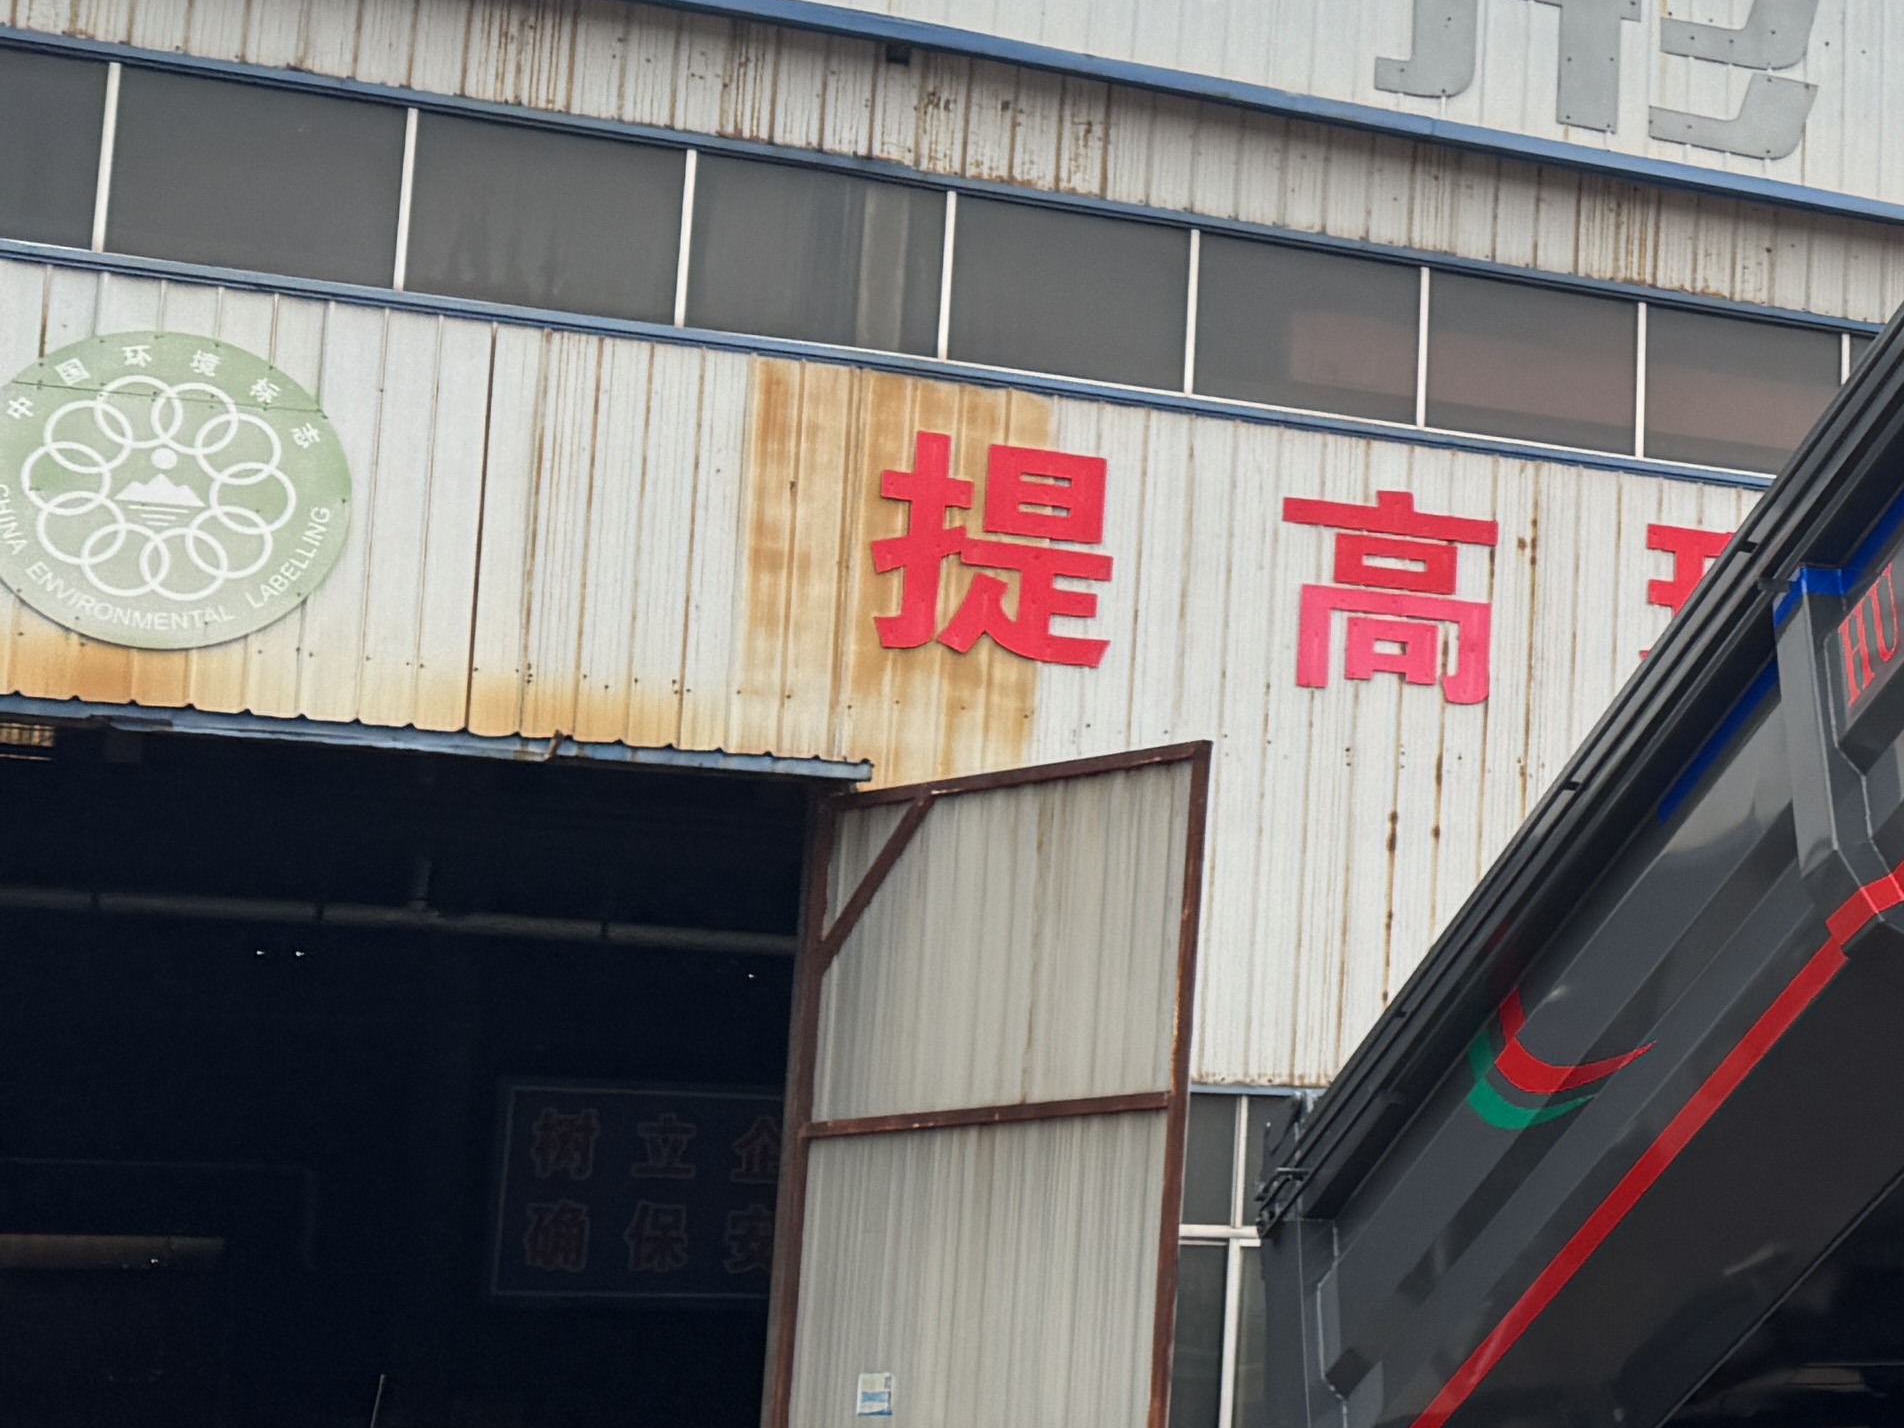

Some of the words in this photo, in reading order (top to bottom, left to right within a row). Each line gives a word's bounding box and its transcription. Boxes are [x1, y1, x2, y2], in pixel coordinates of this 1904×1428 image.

[0, 484, 28, 556] CHINA
[26, 560, 236, 631] ENVIRONMENTAL
[246, 506, 330, 610] LABELLING
